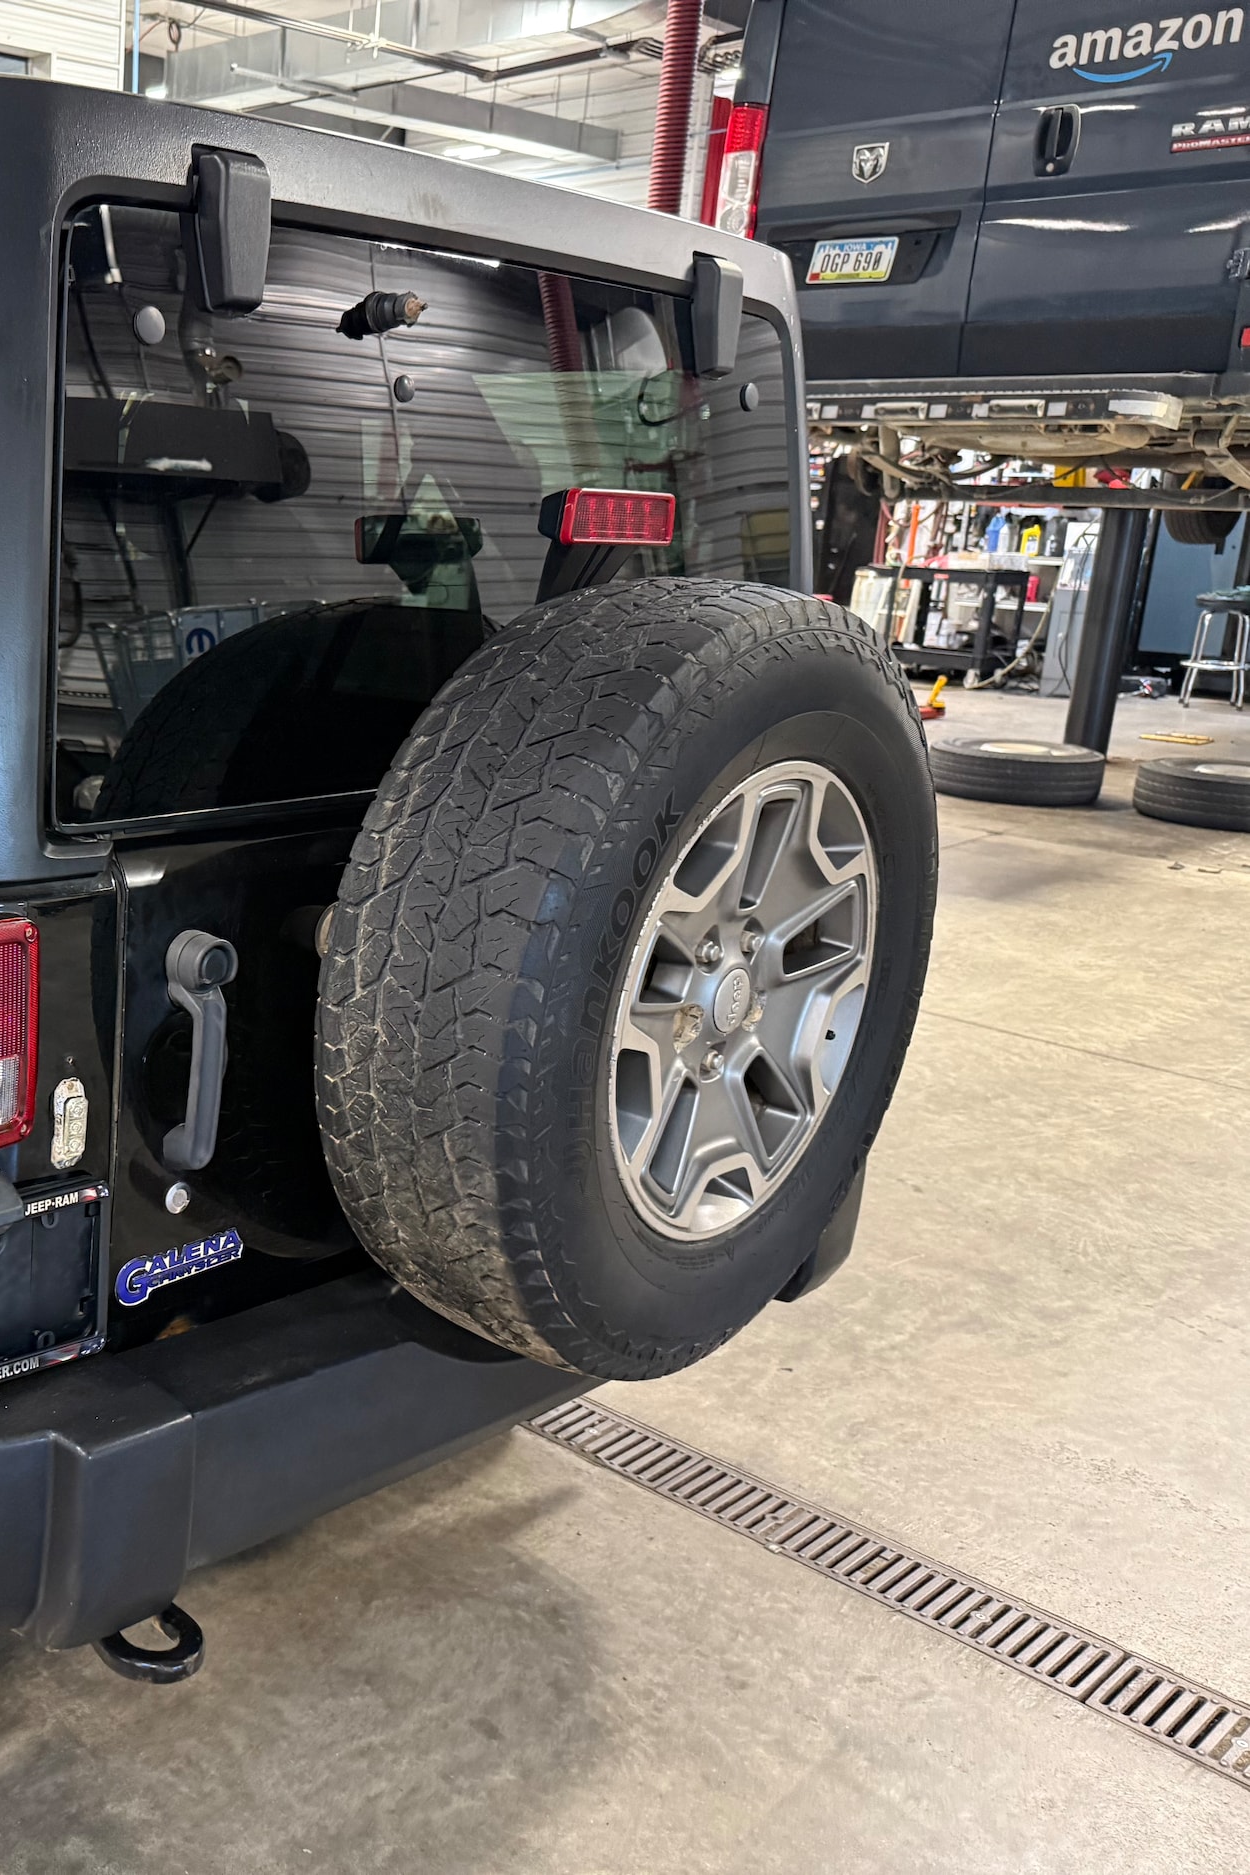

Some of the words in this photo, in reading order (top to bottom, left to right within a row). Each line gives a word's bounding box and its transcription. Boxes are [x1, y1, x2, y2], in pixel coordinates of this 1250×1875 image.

[1049, 7, 1244, 70] amazon
[1171, 117, 1250, 137] RAM
[853, 251, 883, 272] 690
[115, 1228, 242, 1306] GALENA
